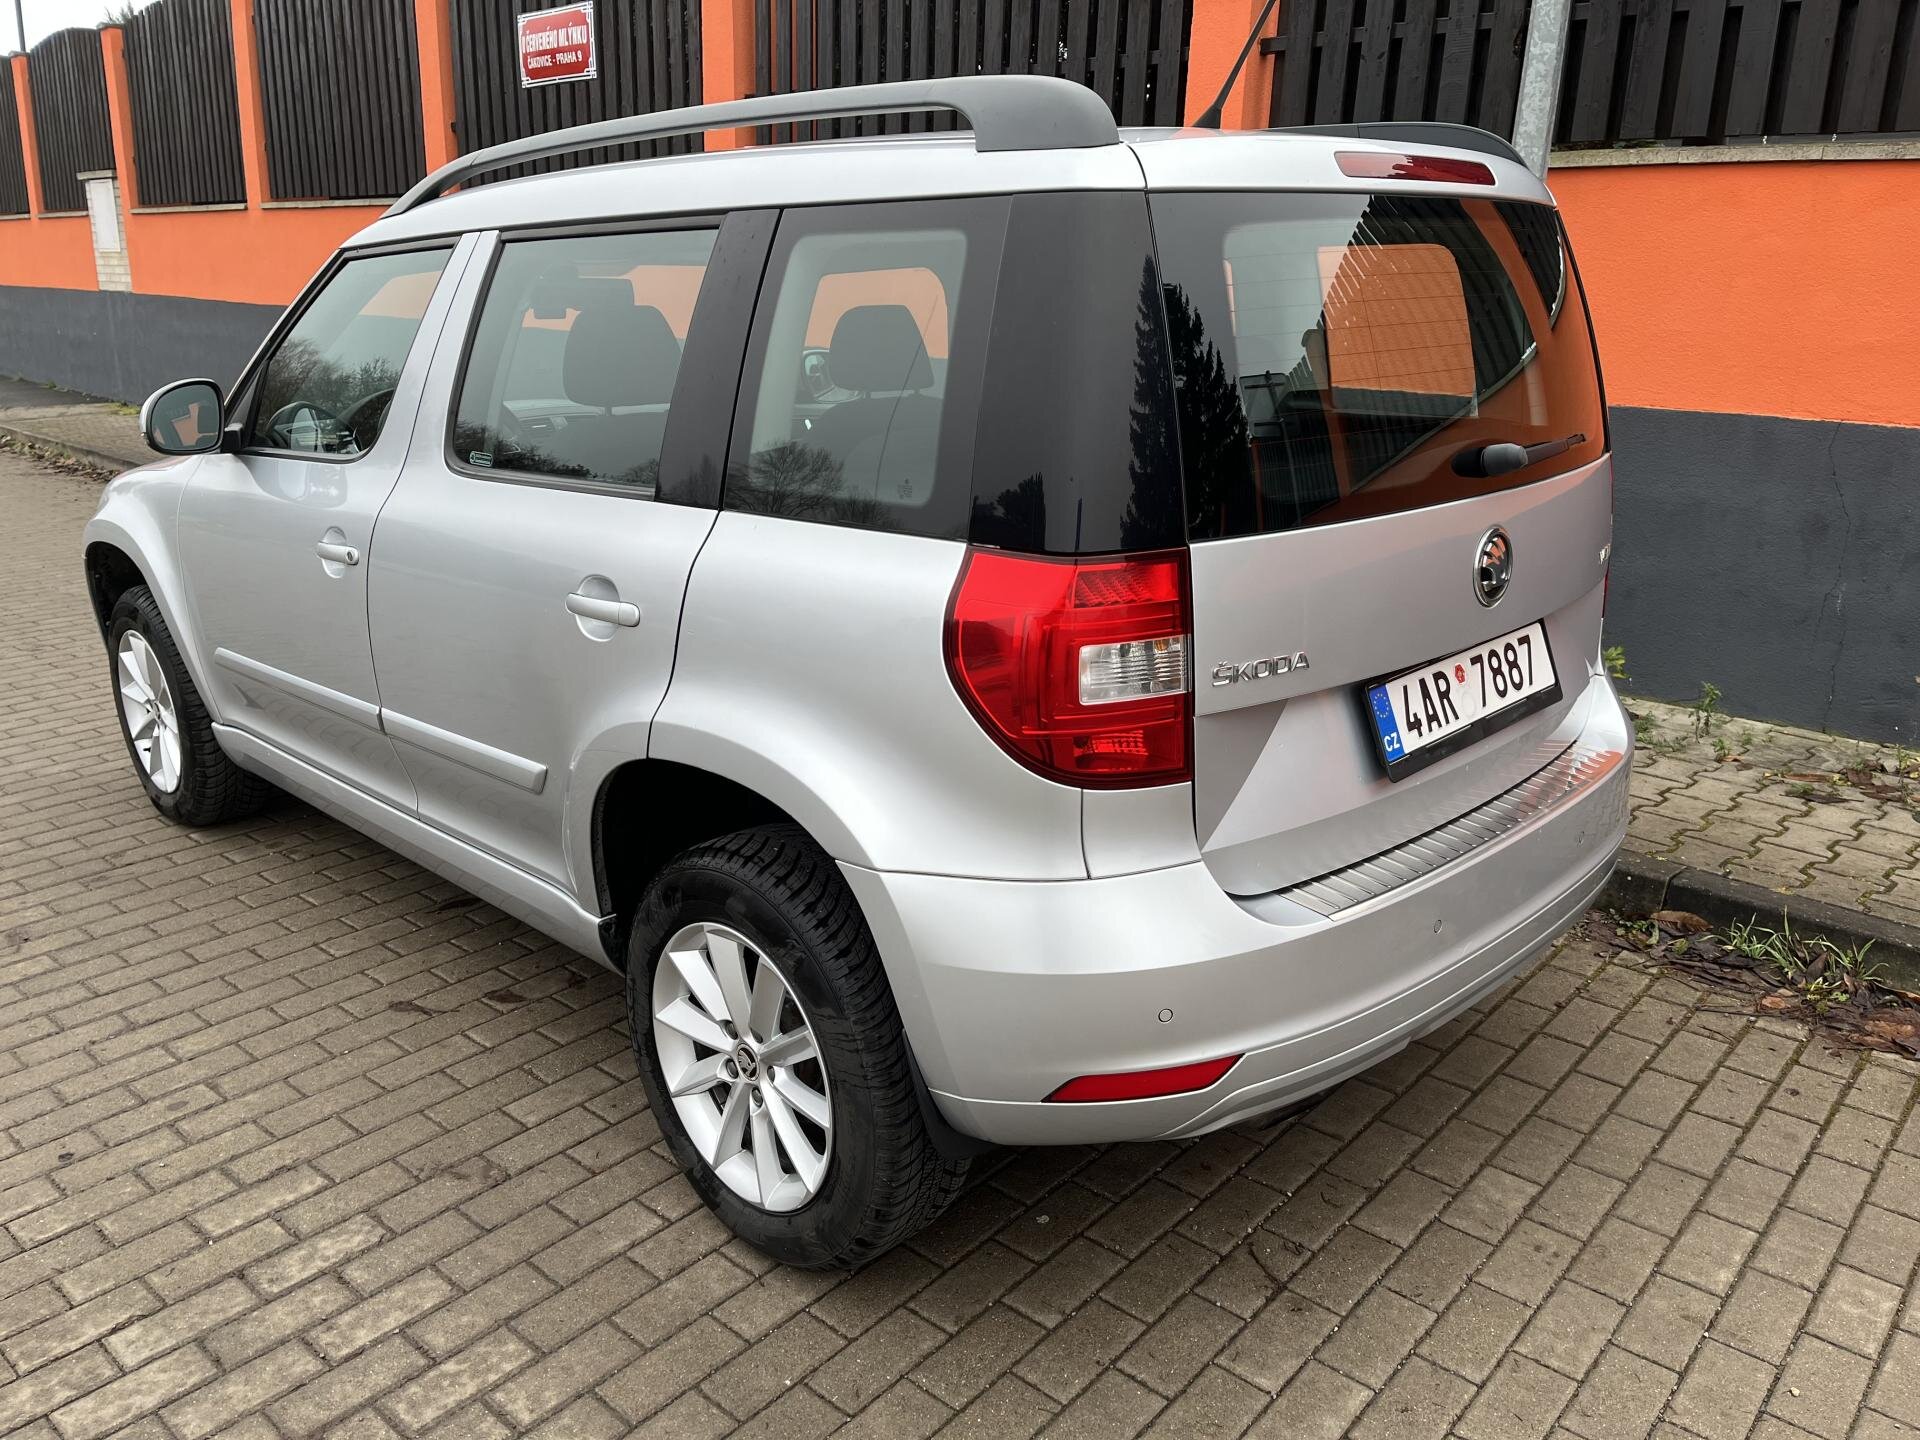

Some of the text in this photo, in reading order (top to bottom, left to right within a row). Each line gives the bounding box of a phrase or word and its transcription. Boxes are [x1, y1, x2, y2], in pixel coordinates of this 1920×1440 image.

[527, 26, 557, 52] ČERVENÉHO
[559, 22, 587, 47] MLÝNKU
[528, 55, 552, 69] ČAKOVICE
[556, 51, 577, 65] PRAHA
[578, 50, 582, 62] 9
[1212, 651, 1310, 687] ŠKODA
[1403, 634, 1533, 737] 4AR 7887
[1384, 731, 1400, 752] CZ
